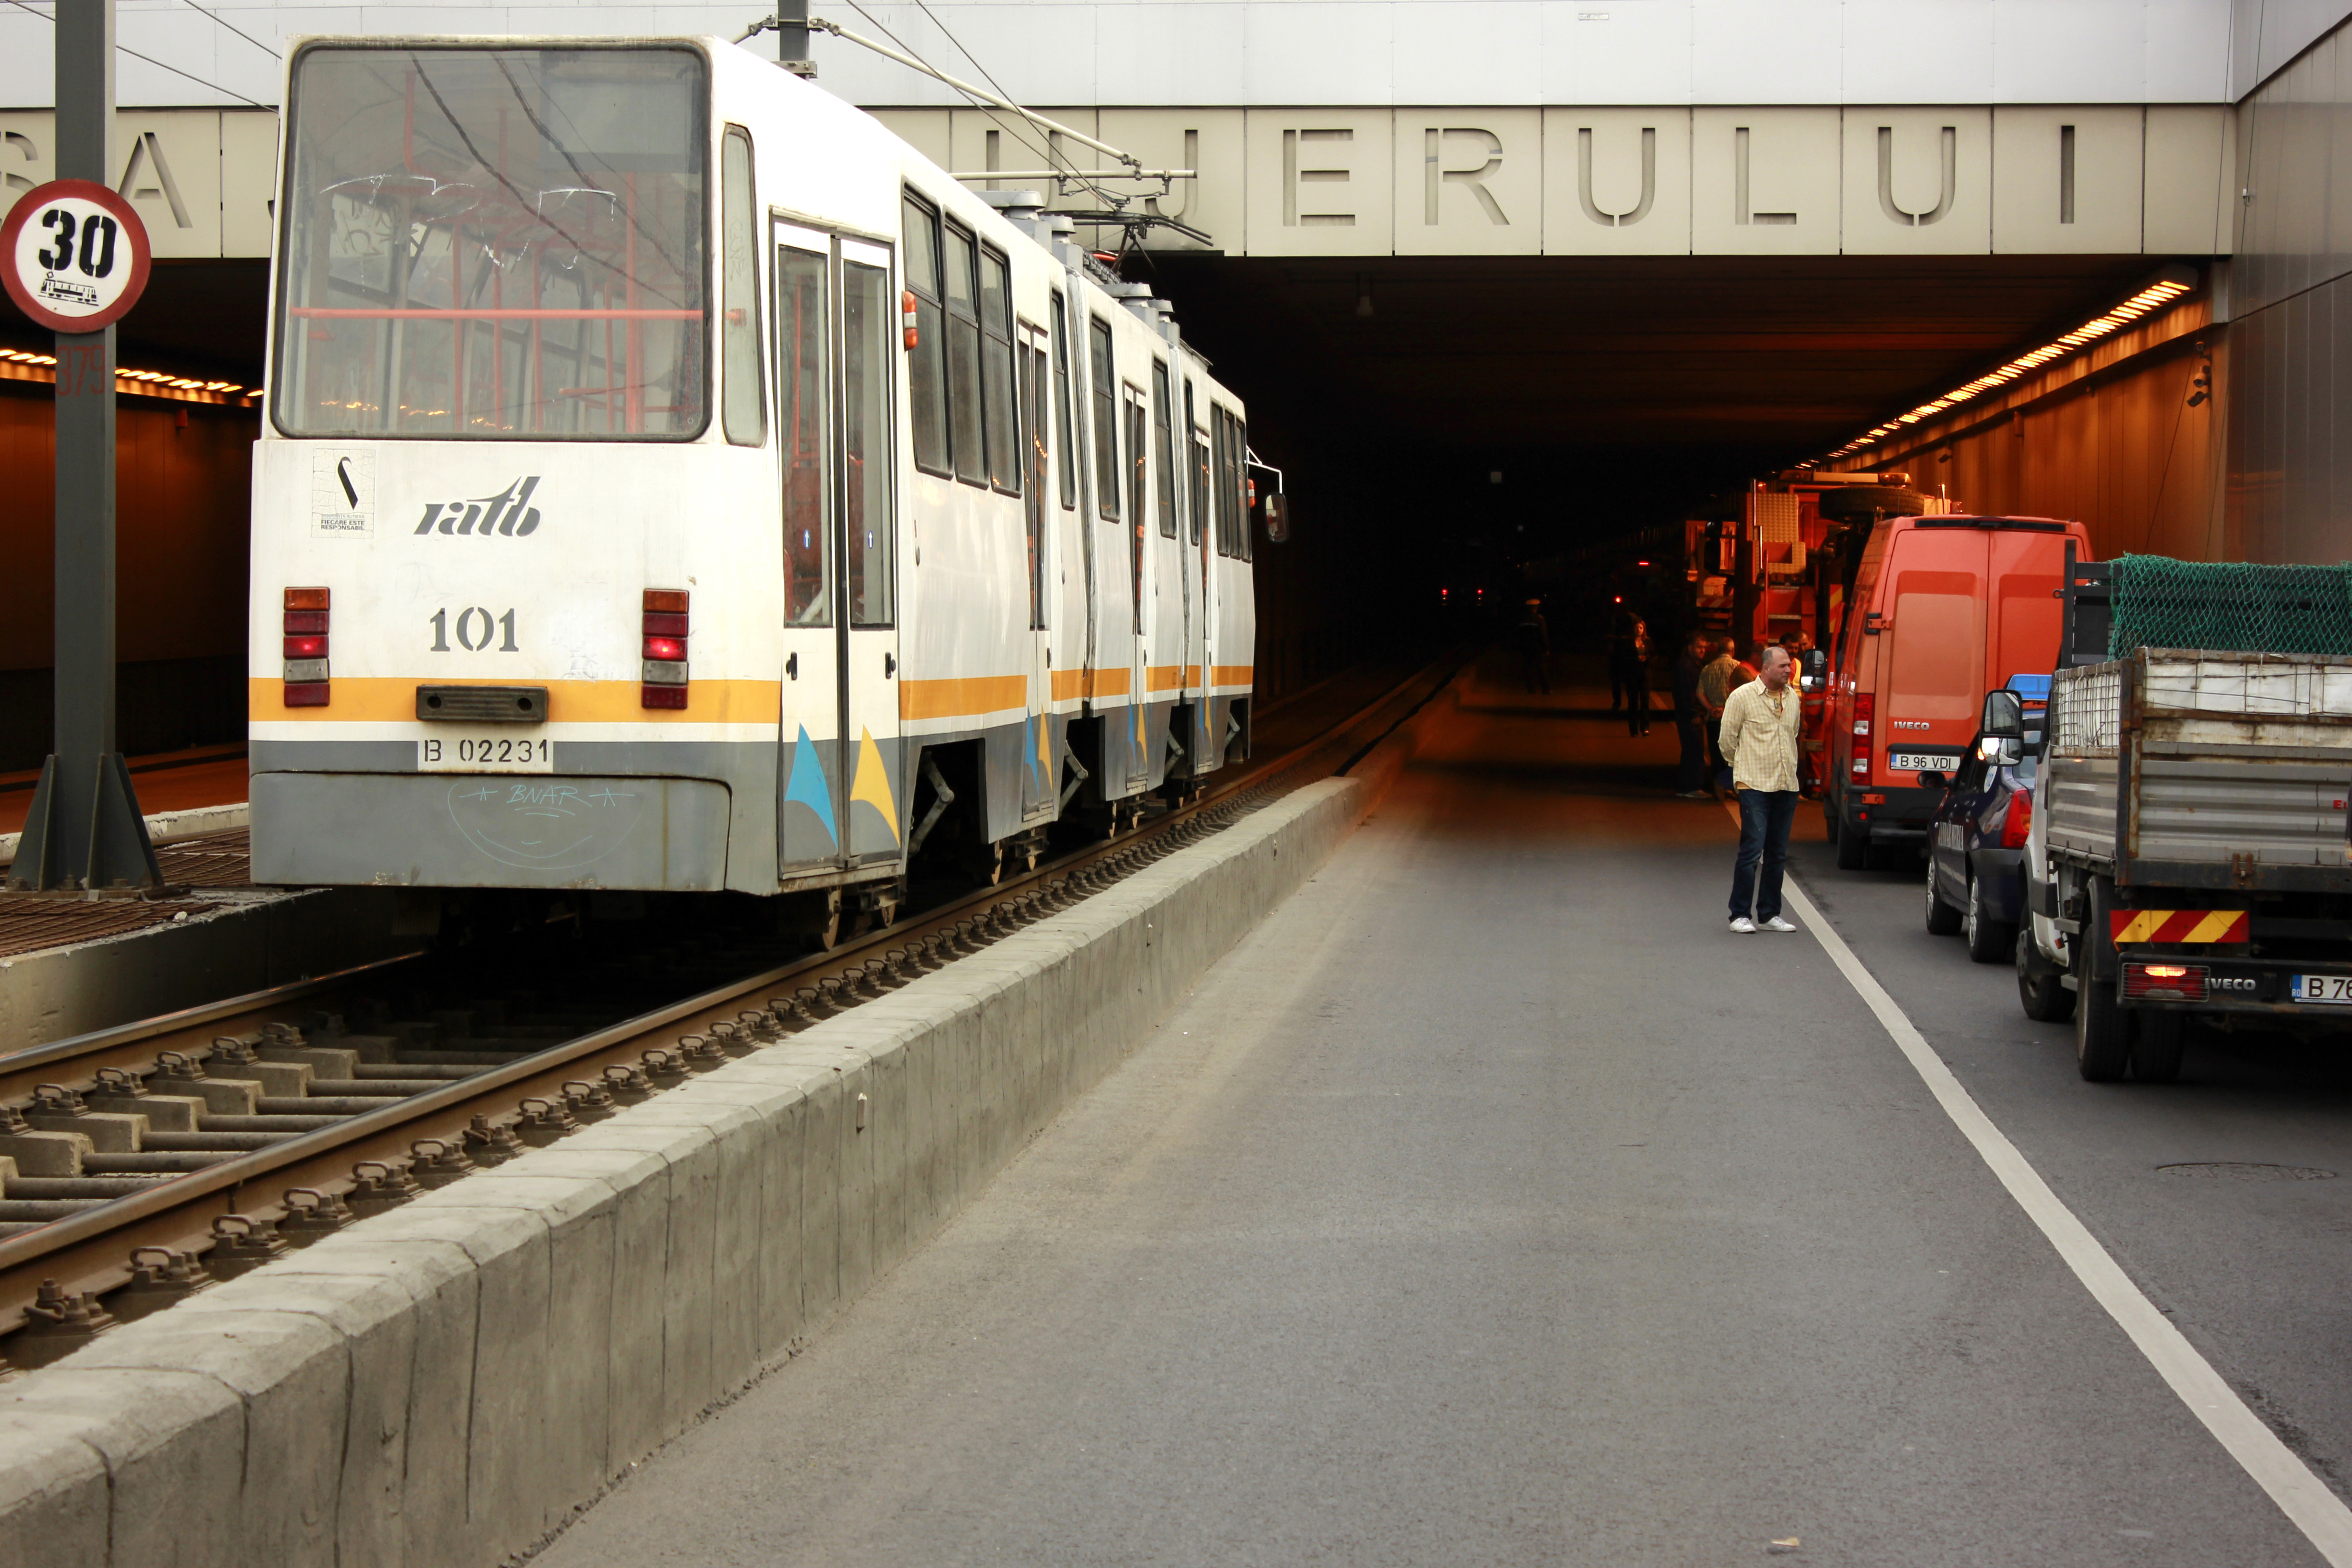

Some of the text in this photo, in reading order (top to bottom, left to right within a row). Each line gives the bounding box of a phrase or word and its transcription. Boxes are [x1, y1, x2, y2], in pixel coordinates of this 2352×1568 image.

[39, 209, 117, 278] 30
[413, 476, 541, 537] ratb
[430, 607, 519, 652] 101
[1894, 721, 1930, 731] IVECO
[424, 739, 547, 763] B 02231
[1901, 756, 1909, 767] B
[1913, 757, 1927, 768] 96
[1932, 757, 1951, 769] VDI
[2205, 978, 2256, 990] IVECO
[2292, 989, 2301, 997] RO
[2308, 978, 2324, 998] B
